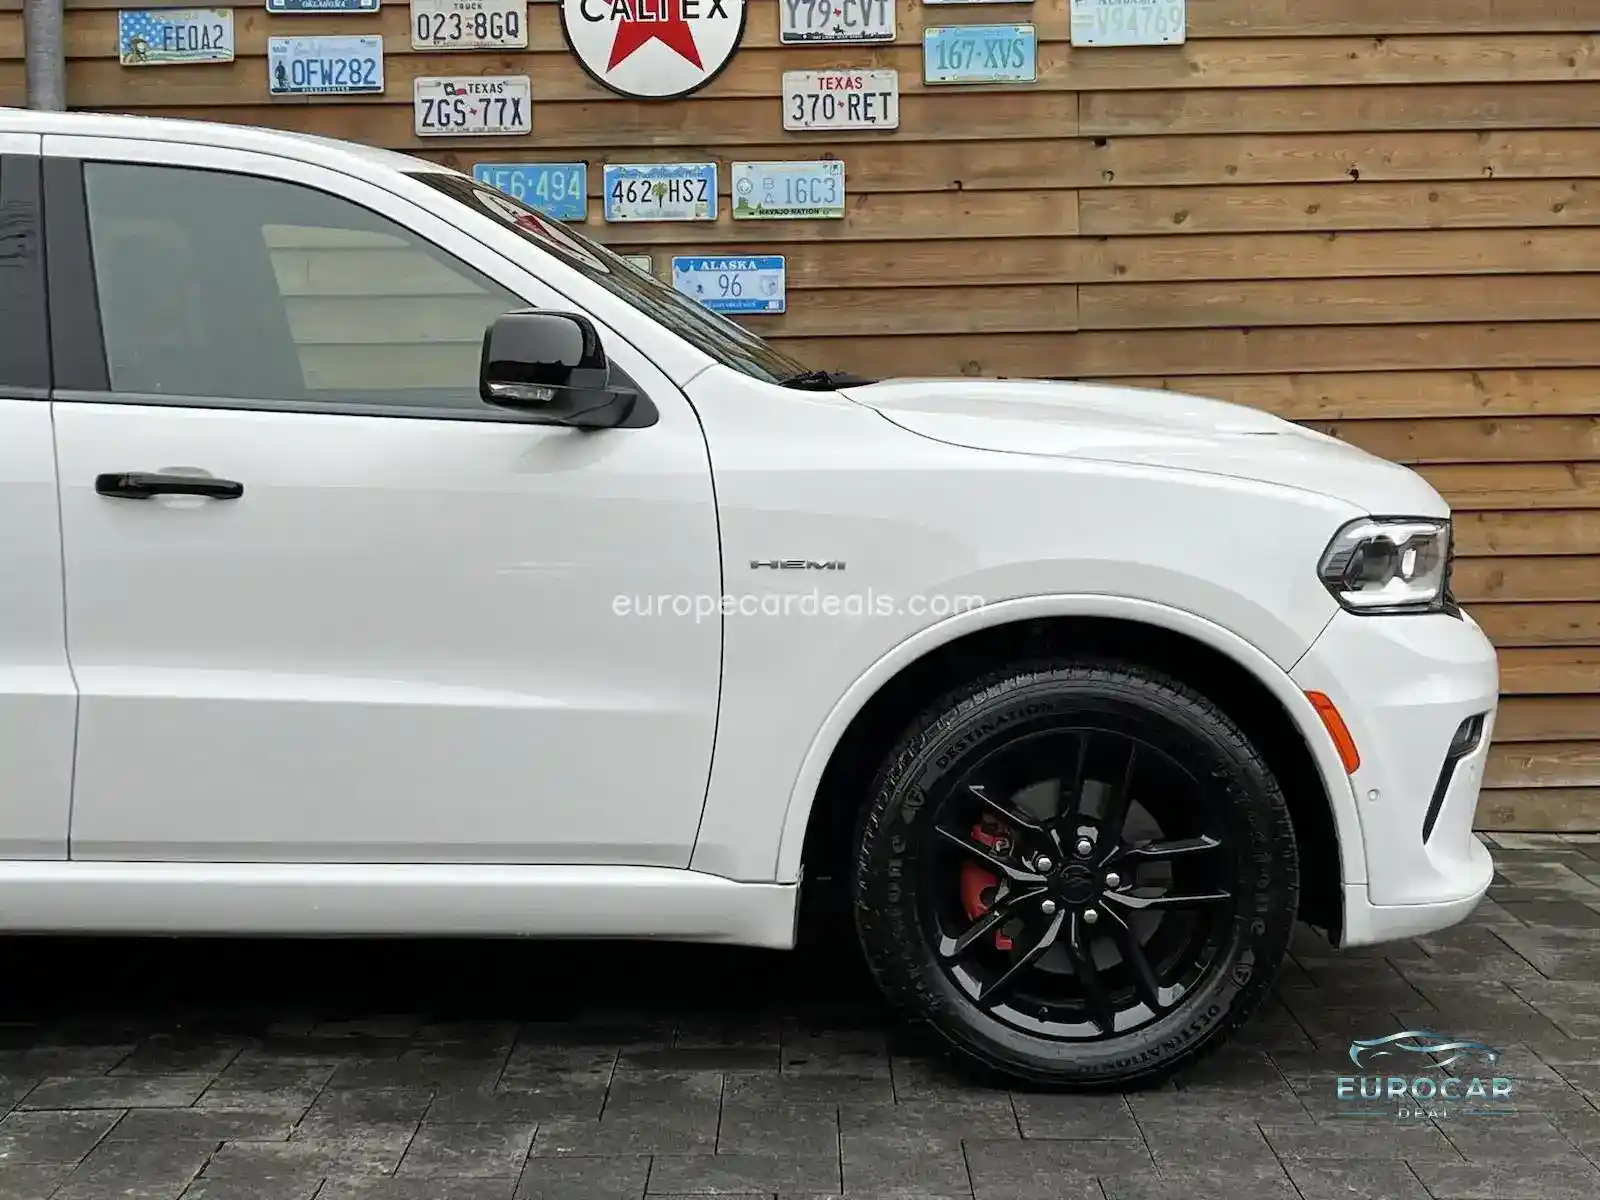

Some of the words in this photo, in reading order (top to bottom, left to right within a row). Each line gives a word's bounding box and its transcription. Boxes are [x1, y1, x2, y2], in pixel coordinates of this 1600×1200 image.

[468, 83, 504, 94] TEXAS
[818, 77, 863, 90] TEXAS
[612, 180, 652, 203] 462
[668, 179, 708, 203] HSZ
[791, 207, 820, 215] NATION
[700, 260, 758, 271] ALASKA
[718, 273, 742, 298] 96
[750, 560, 846, 570] HEMI
[936, 700, 1056, 769] DESTINATION
